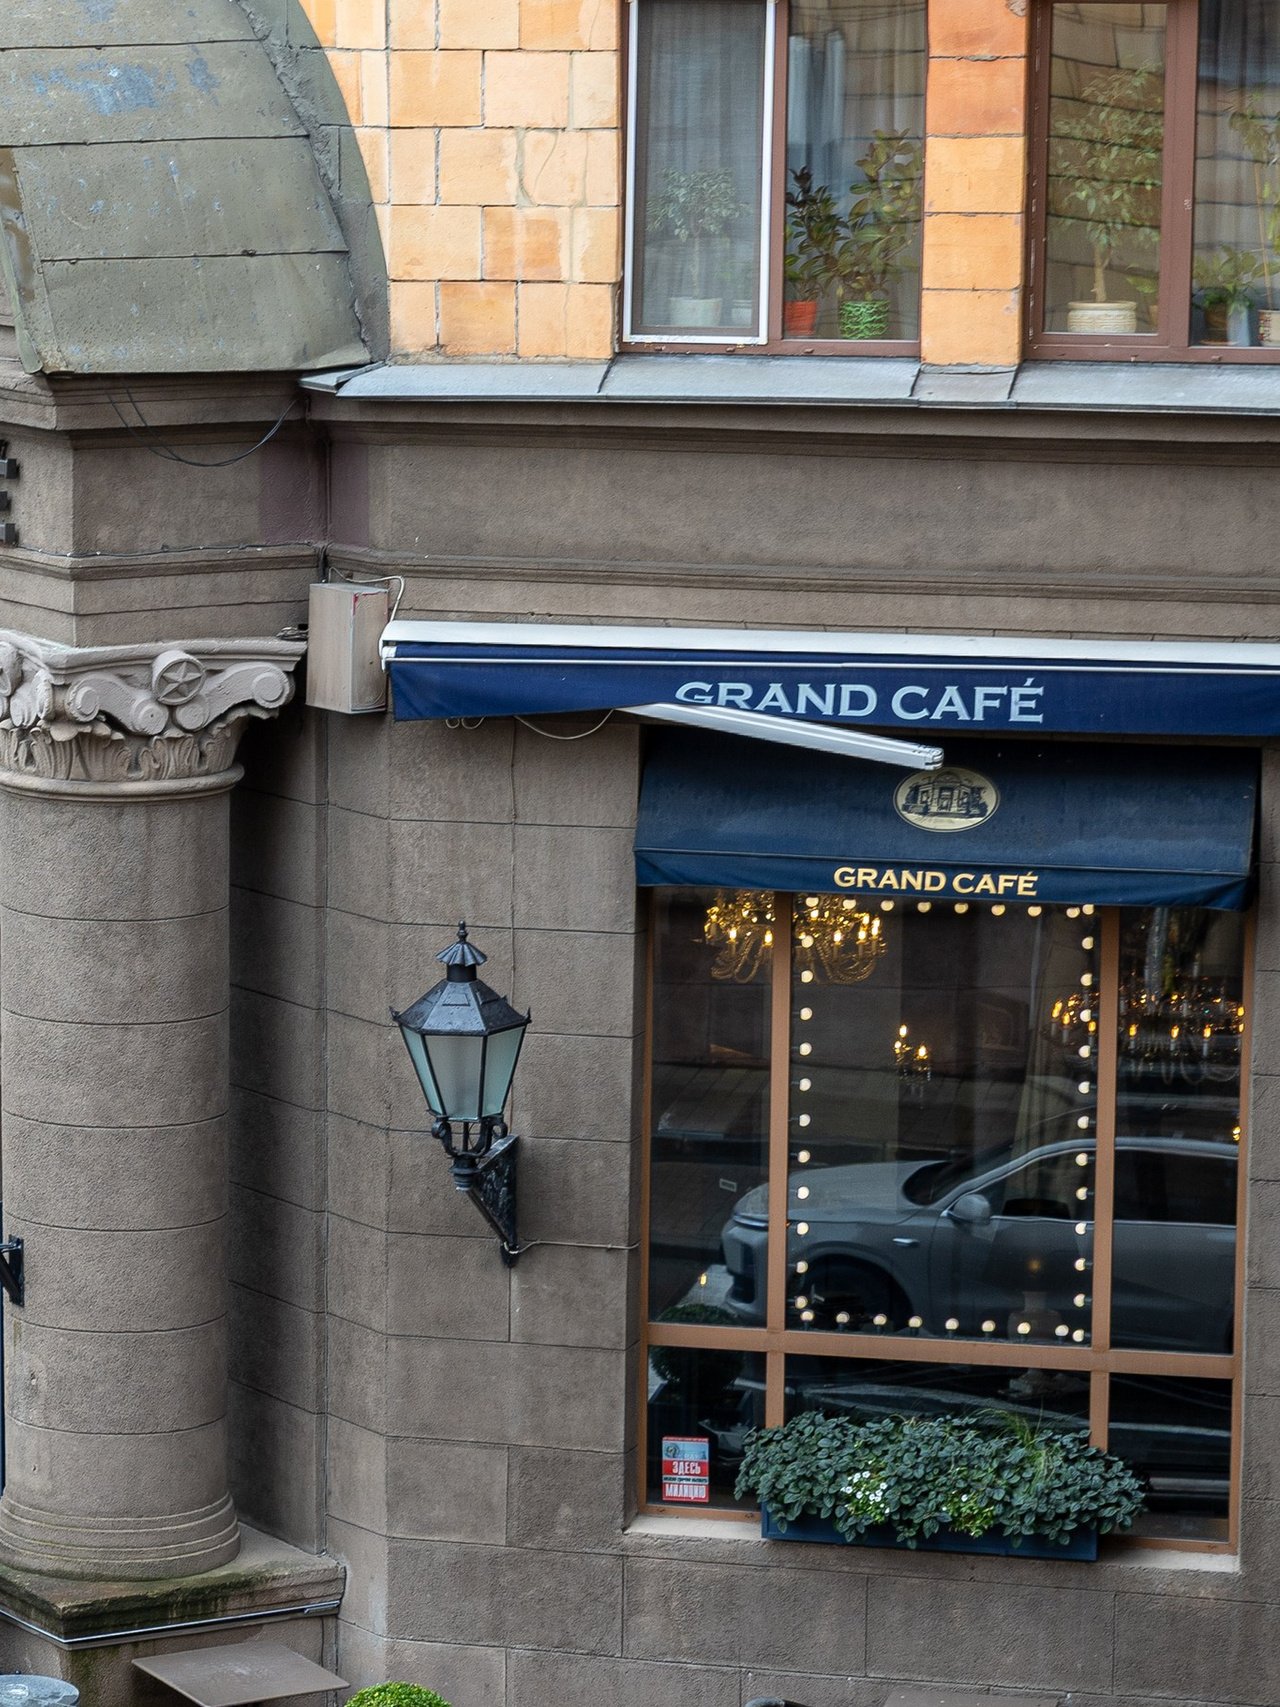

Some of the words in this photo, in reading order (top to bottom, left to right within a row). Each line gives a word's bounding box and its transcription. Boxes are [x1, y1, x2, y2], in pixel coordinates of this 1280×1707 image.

[674, 681, 878, 717] GRAND
[891, 678, 1044, 724] CAFÉ
[833, 867, 947, 893] GRAND
[952, 871, 1039, 897] CAFÉ
[672, 1461, 701, 1475] ЗДЕСЬ
